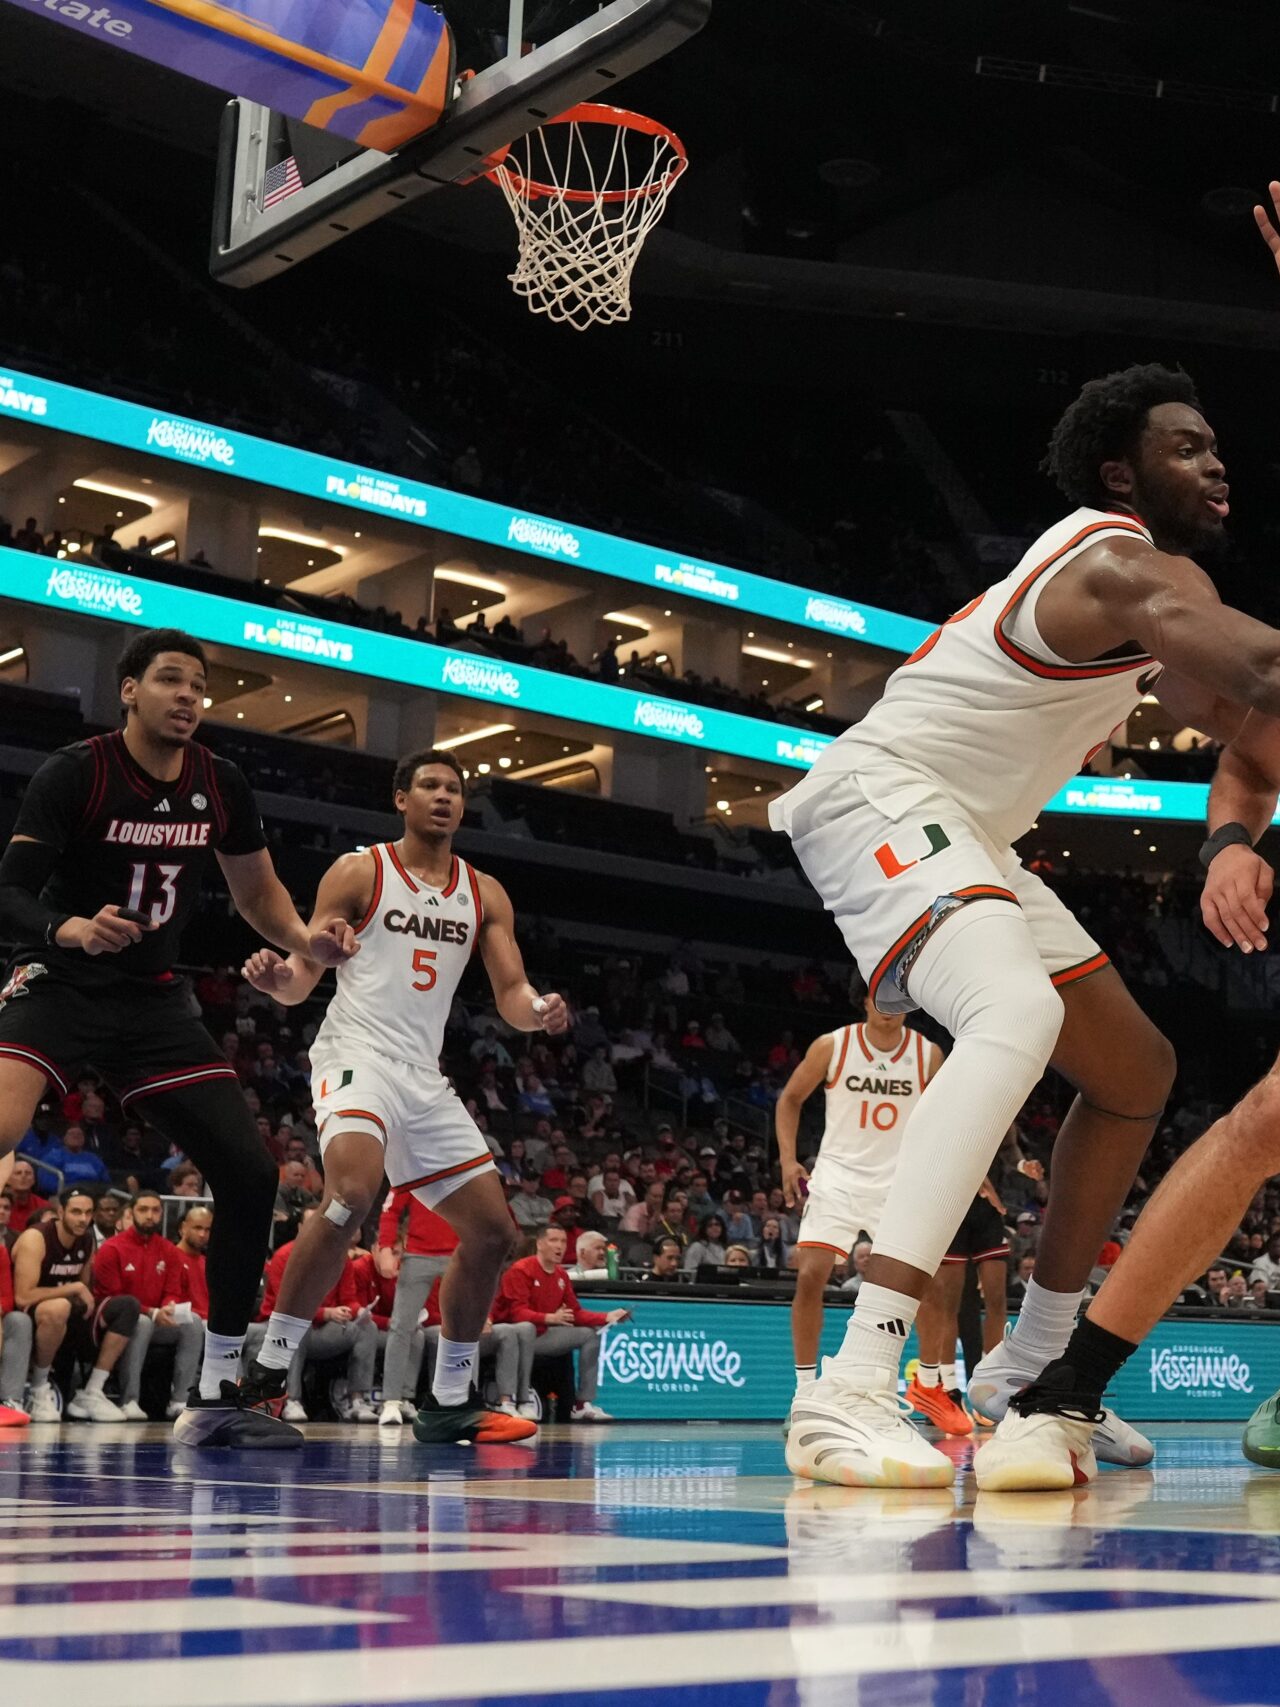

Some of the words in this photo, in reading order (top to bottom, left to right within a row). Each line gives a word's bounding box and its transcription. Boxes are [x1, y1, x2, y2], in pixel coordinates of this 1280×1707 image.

[30, 0, 133, 38] tate
[326, 475, 427, 517] FLORIDAYS
[244, 621, 353, 662] FLORIDAYS
[105, 819, 211, 847] LOUISVILLE
[127, 863, 182, 924] 13
[383, 909, 470, 946] CANES
[411, 948, 438, 992] 5
[845, 1075, 913, 1097] CANES
[859, 1100, 898, 1131] 10
[633, 1328, 706, 1340] EXPERIENCE
[1172, 1345, 1224, 1354] EXPERIENCE
[597, 1326, 746, 1388] Kissimmee
[1149, 1348, 1255, 1393] Kissimmee
[647, 1383, 699, 1392] FLORIDA
